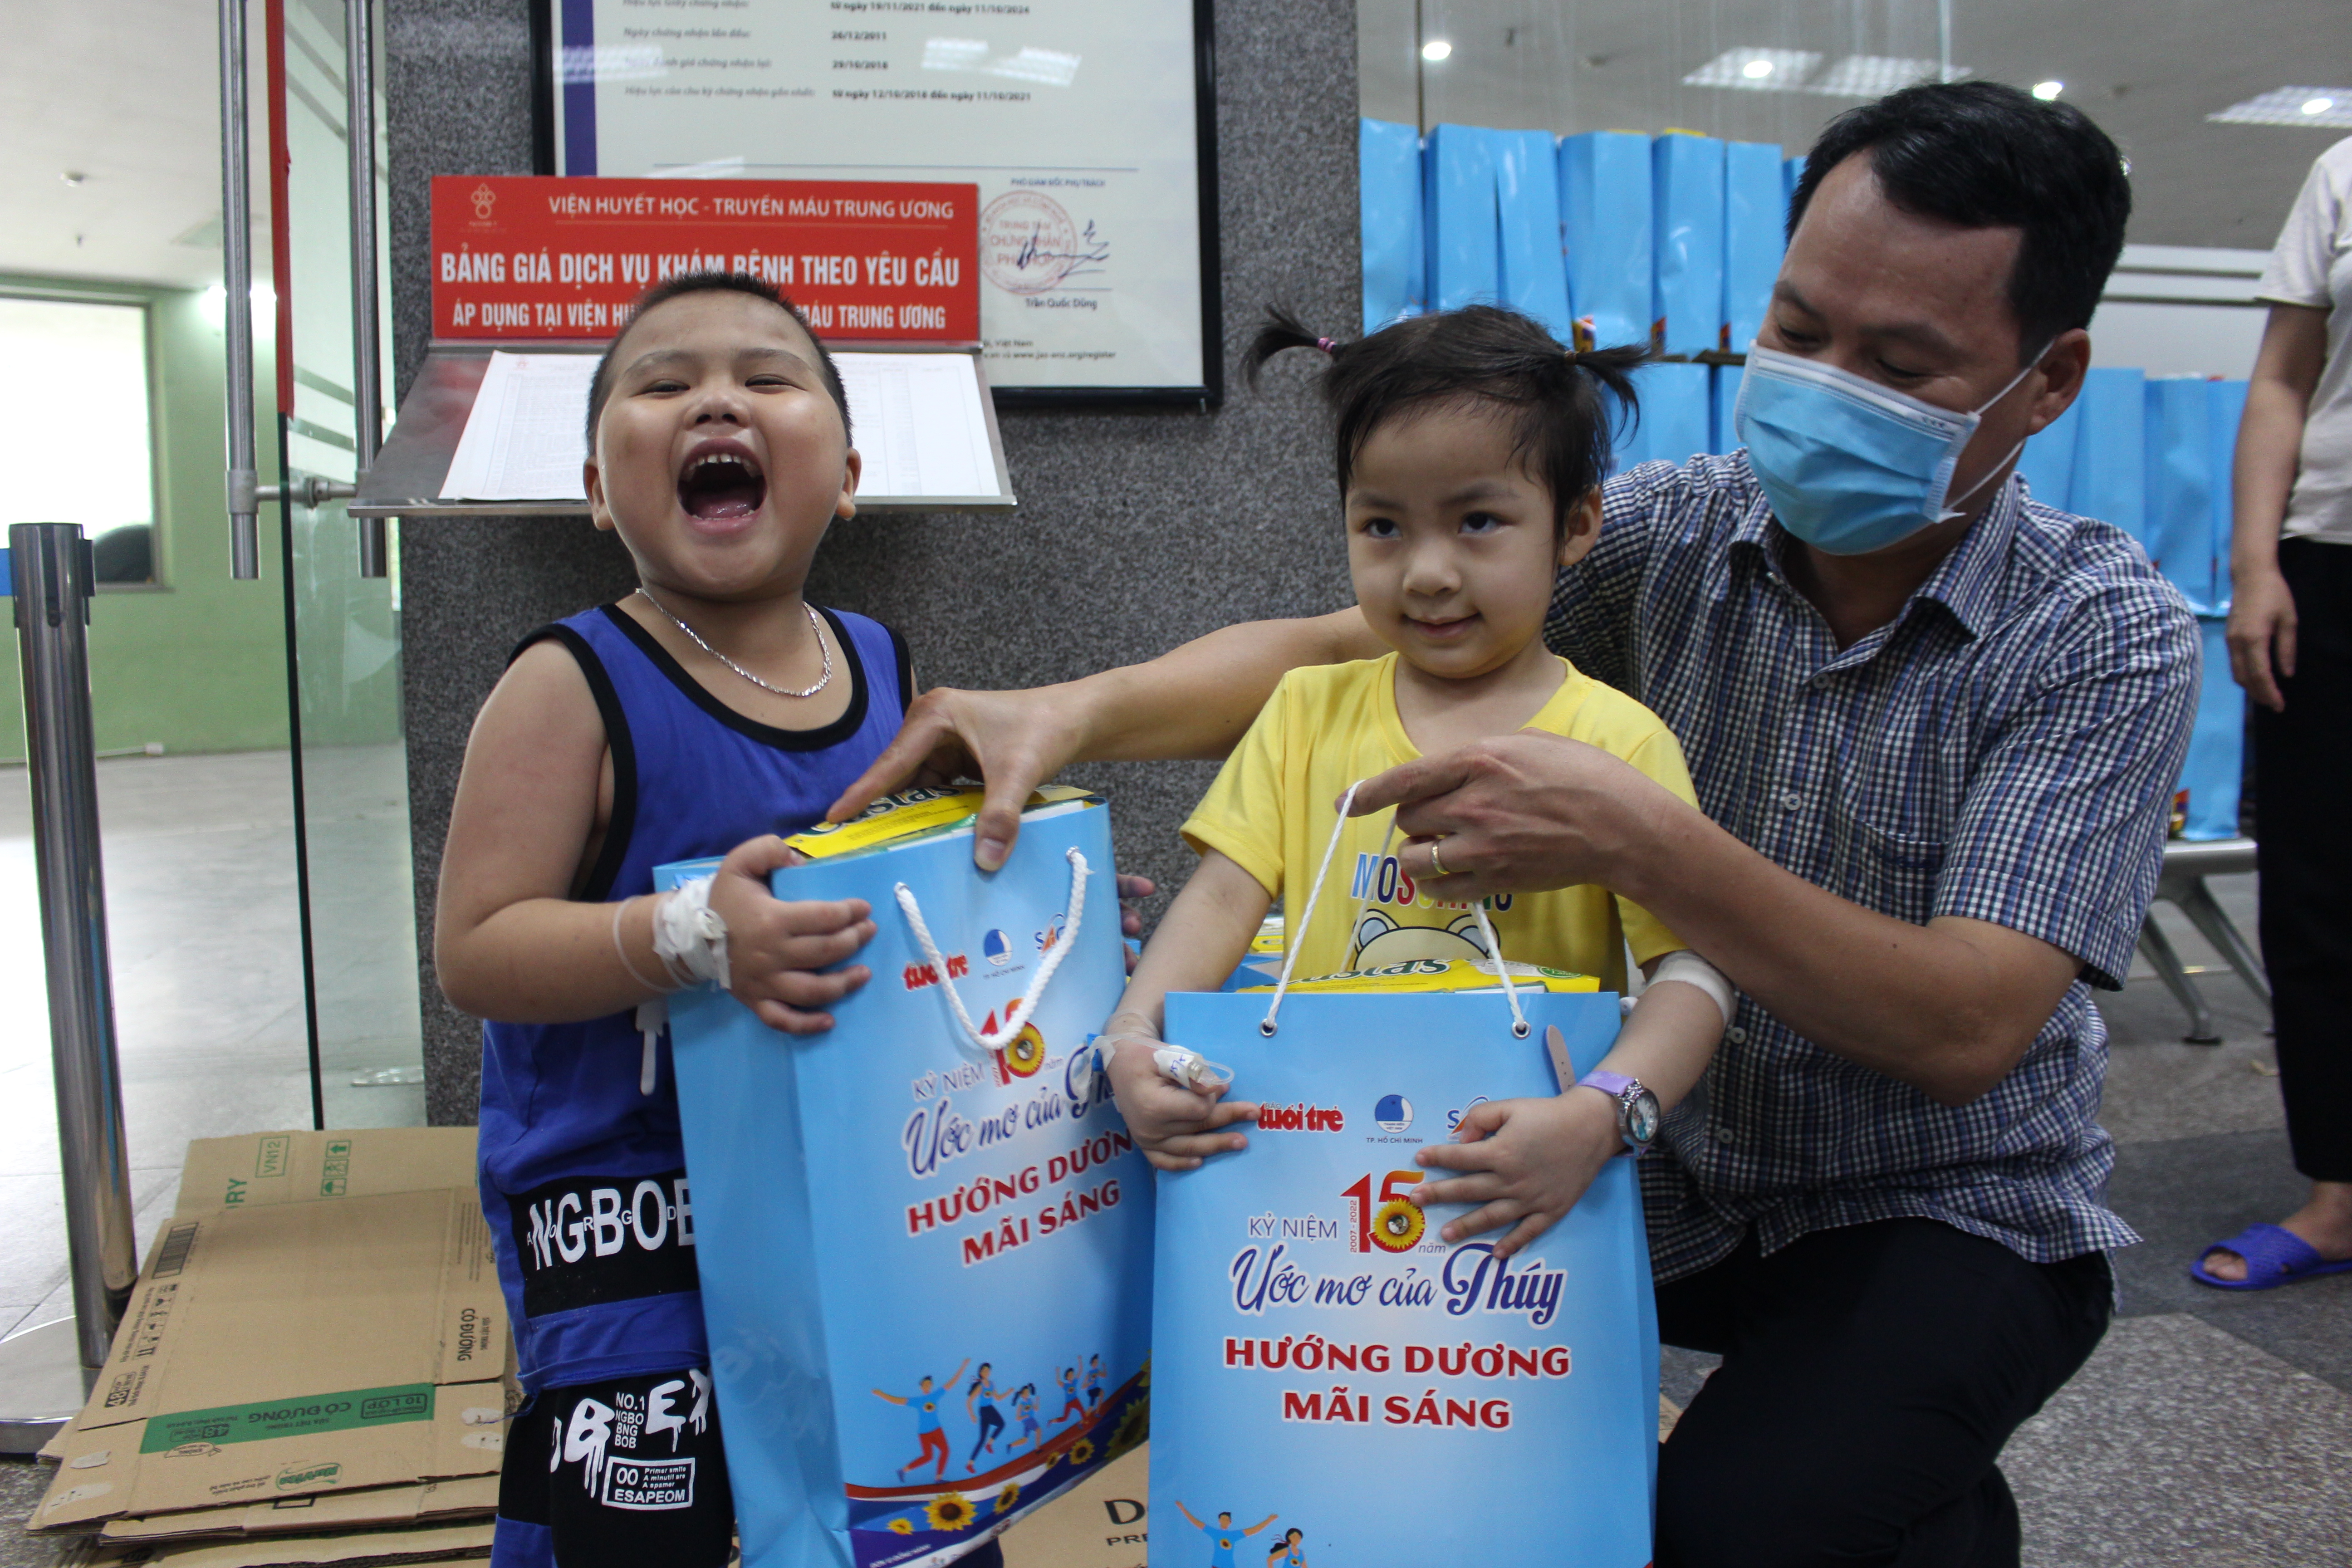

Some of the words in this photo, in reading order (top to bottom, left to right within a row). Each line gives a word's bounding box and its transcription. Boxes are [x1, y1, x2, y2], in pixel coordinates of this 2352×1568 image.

[548, 193, 591, 218] VIỆN
[595, 191, 656, 215] HUYẾT
[660, 196, 700, 219] HỌC
[789, 196, 830, 217] MÁU
[833, 198, 896, 218] TRUNG
[899, 199, 954, 219] ƯƠNG
[441, 242, 505, 283] BẢNG
[513, 247, 552, 283] GIÁ
[559, 253, 614, 290] DỊCH
[620, 253, 651, 289] VỤ
[800, 255, 858, 286] THEO
[865, 250, 907, 286] YÊU
[452, 298, 476, 327] ÁP
[481, 303, 530, 332] DỤNG
[534, 303, 562, 332] TẠI
[567, 298, 609, 332] VIỆN
[839, 304, 894, 329] TRUNG
[899, 303, 946, 330] ƯƠNG
[906, 1100, 972, 1175] Ước
[979, 1104, 1019, 1147] mơ
[1025, 1086, 1061, 1130] của
[1304, 1105, 1344, 1133] trẻ
[263, 1141, 281, 1174] VN12
[908, 1166, 1039, 1233] HƯỚNG
[1048, 1128, 1133, 1184] DƯƠN
[963, 1216, 1029, 1264] MÃI
[1039, 1180, 1120, 1235] SÁNG
[1339, 1170, 1426, 1254] 15
[1349, 1200, 1358, 1224] 2022
[1249, 1213, 1275, 1237] KỶ
[1283, 1214, 1338, 1241] NIỆM
[1418, 1243, 1446, 1254] năm
[1349, 1230, 1358, 1253] 2007
[1232, 1244, 1309, 1312] Ước
[1314, 1274, 1373, 1306] mơ
[1379, 1268, 1439, 1307] của
[1442, 1242, 1564, 1325] Thúy
[461, 1308, 478, 1322] CÓ
[1226, 1334, 1390, 1373] HƯỚNG
[1404, 1343, 1570, 1377] DƯƠNG
[615, 1392, 645, 1411] NO.1
[615, 1410, 644, 1425] NGBO
[1284, 1386, 1369, 1422] MÃI
[1384, 1389, 1510, 1429] SÁNG
[615, 1436, 637, 1449] BOB
[616, 1424, 638, 1437] BNG
[614, 1489, 686, 1504] ESAPEOM
